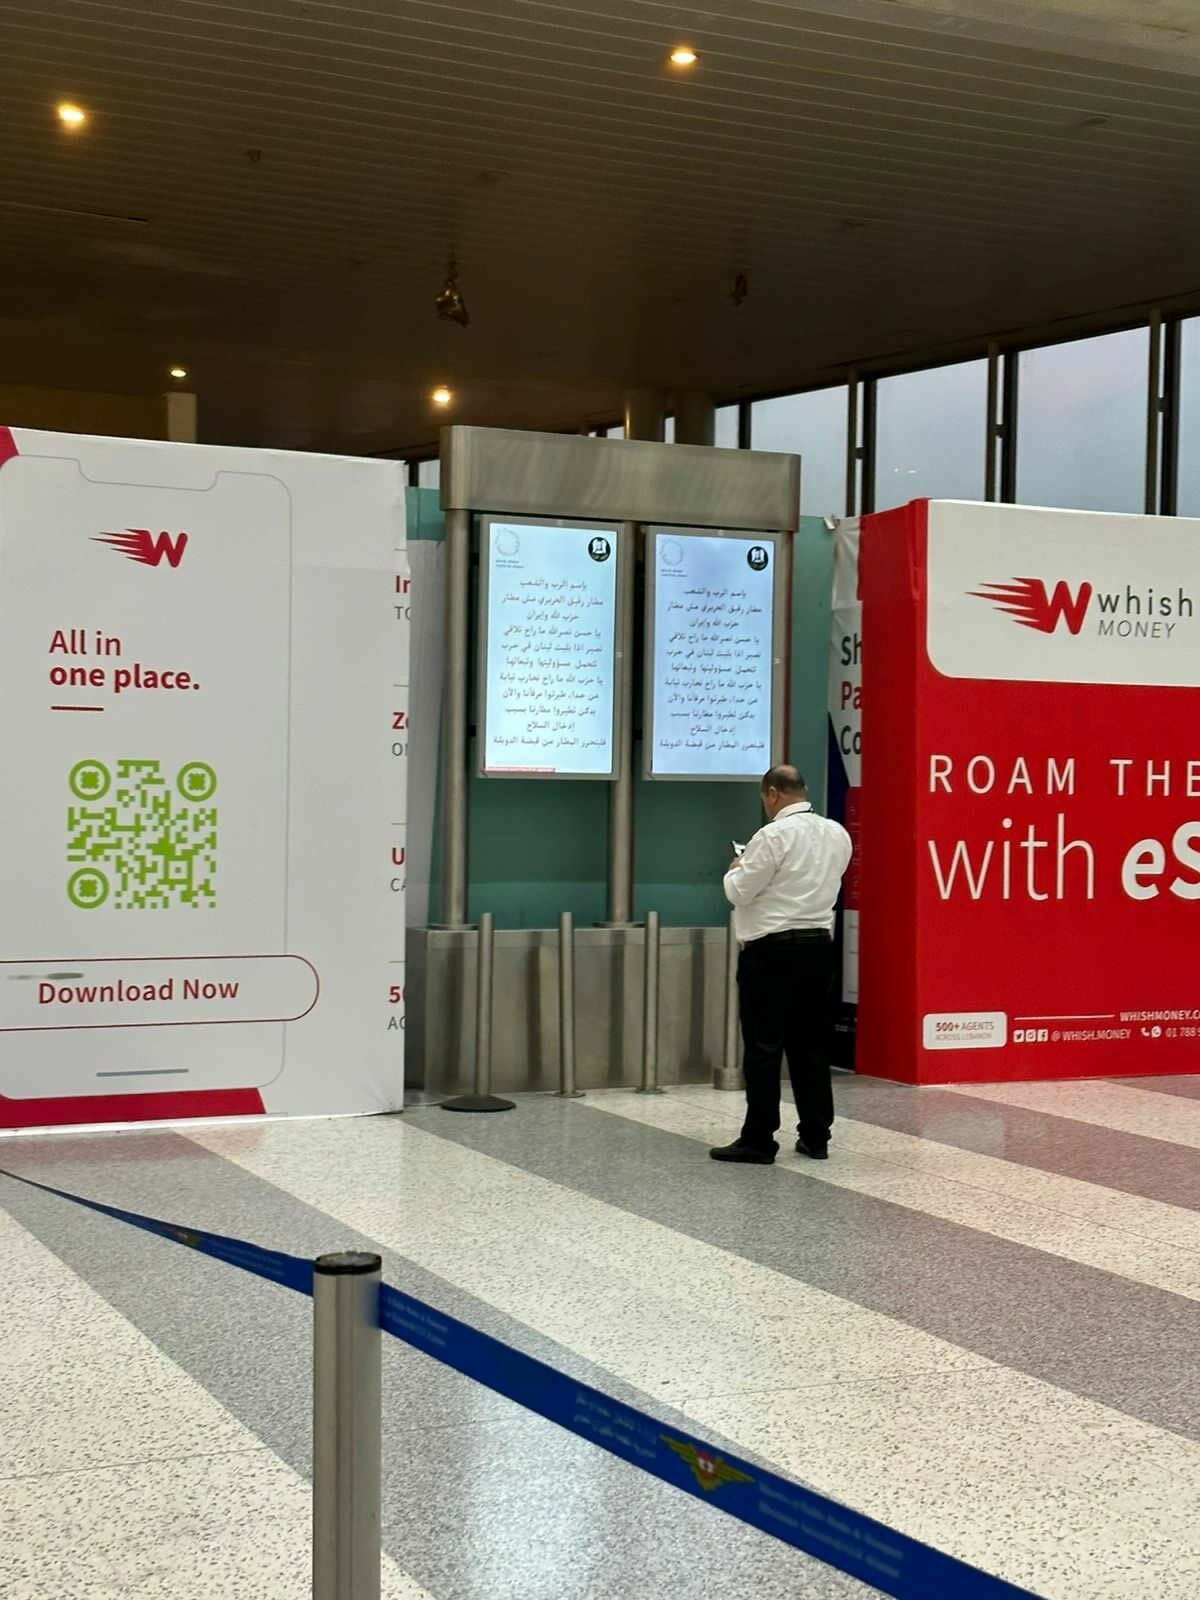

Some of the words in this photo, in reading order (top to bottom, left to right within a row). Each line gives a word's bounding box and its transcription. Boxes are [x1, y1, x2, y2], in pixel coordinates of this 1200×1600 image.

[89, 528, 188, 568] W
[1097, 585, 1193, 617] whish
[49, 629, 87, 655] All
[96, 631, 121, 656] in
[1098, 620, 1176, 638] MONEY
[49, 666, 105, 686] one
[114, 664, 200, 693] place.
[929, 754, 1075, 796] ROAM
[1109, 759, 1200, 797] THE
[927, 813, 1094, 901] with
[1121, 821, 1200, 901] eS
[39, 978, 174, 1004] Download
[183, 979, 240, 1000] Now
[389, 986, 406, 1003] 5
[935, 1022, 959, 1031] 500+
[961, 1021, 995, 1031] AGENTS
